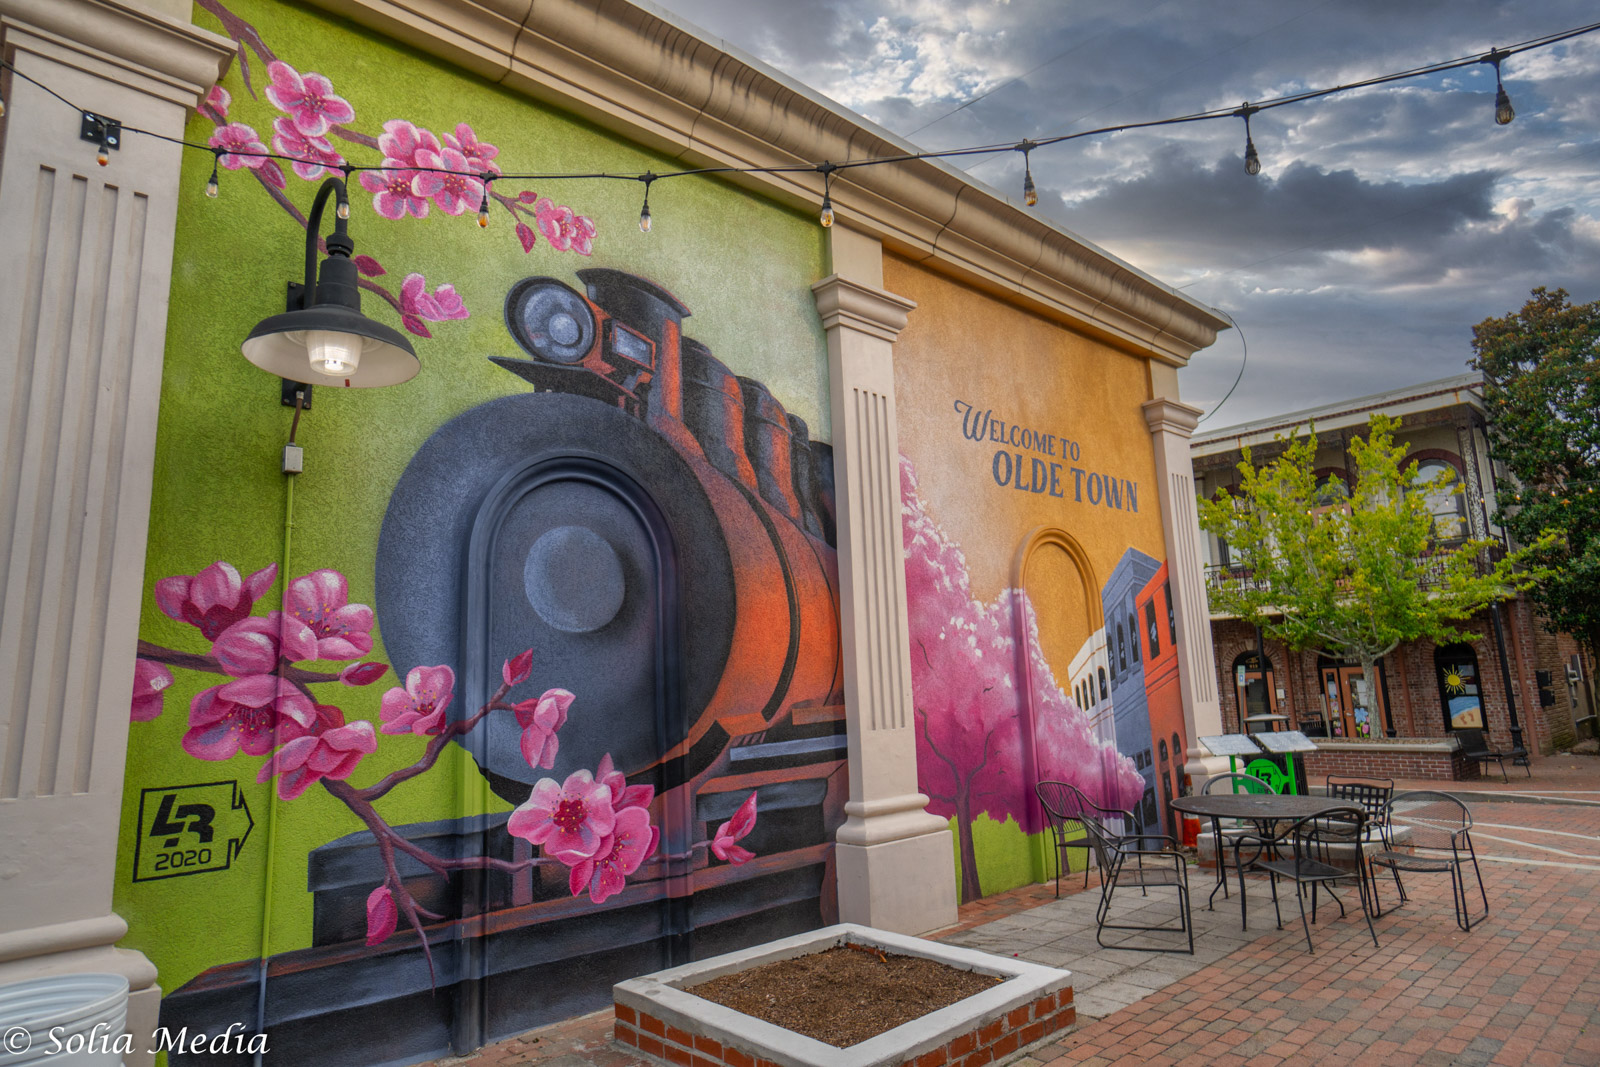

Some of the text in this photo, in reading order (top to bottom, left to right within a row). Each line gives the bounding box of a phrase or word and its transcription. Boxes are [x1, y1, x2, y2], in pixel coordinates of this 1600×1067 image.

[1060, 438, 1080, 462] TO
[992, 450, 1138, 513] OLDE TOWN
[149, 794, 216, 848] LR
[155, 848, 212, 871] 2020
